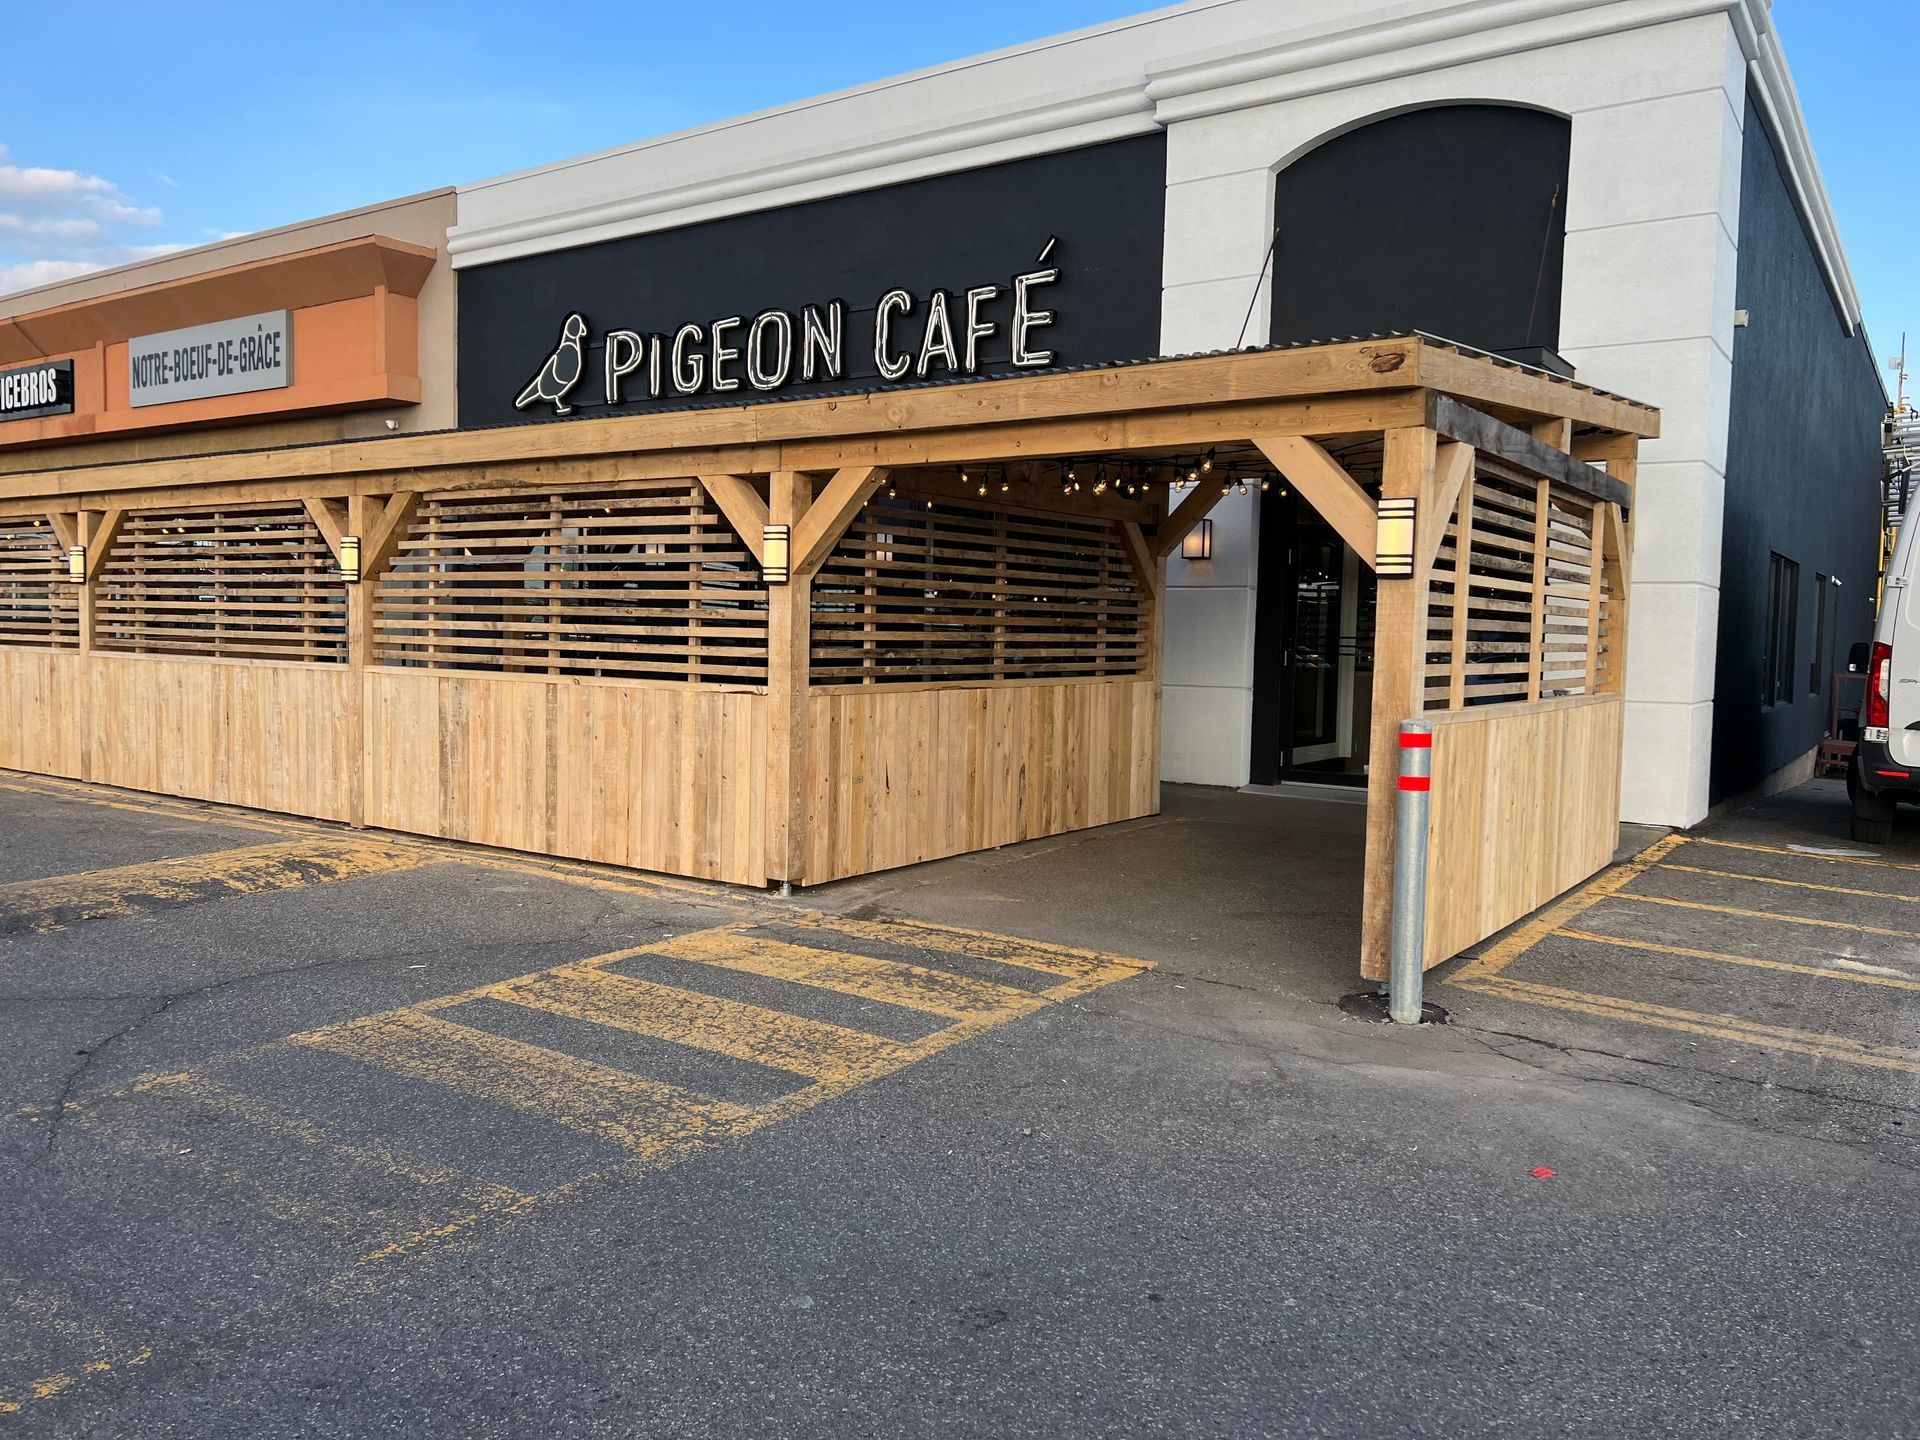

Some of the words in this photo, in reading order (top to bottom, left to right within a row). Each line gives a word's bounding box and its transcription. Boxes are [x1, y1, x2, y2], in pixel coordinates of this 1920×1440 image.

[605, 301, 842, 404] PIGEON
[874, 237, 1059, 380] CAFÉ
[1, 368, 57, 410] ICEBROS
[132, 323, 281, 389] NOTRE-BOEUF-DE-GRÂCE
